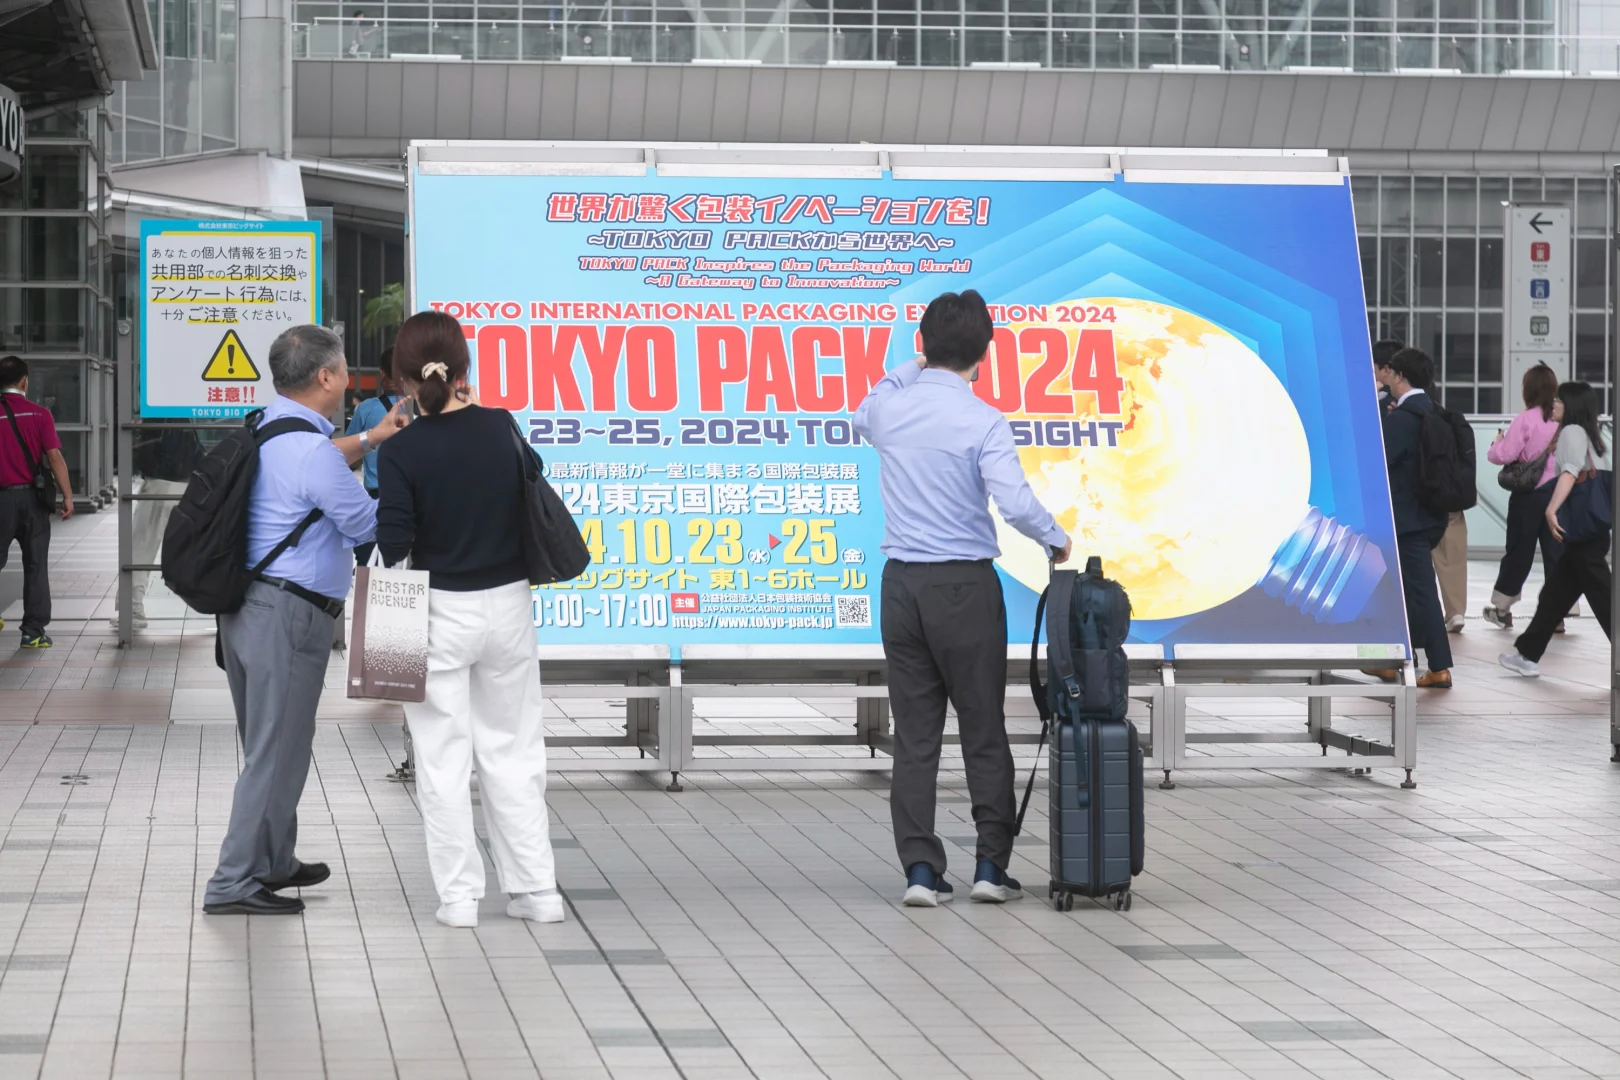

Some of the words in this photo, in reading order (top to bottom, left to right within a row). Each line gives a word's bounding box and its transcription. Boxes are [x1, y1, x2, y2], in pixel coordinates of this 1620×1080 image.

[548, 194, 991, 224] 世界が驚く包装イノベーションを!
[152, 247, 308, 260] あなたの個人情報を狙った
[151, 264, 308, 281] 共用部での名刺交換や
[579, 257, 637, 270] TOKYO
[641, 257, 689, 270] PACK
[694, 258, 775, 272] Inspires
[780, 258, 812, 271] the
[818, 258, 914, 274] Packaging
[919, 259, 971, 272] World
[676, 275, 755, 289] Gateway
[761, 277, 781, 288] to
[151, 285, 308, 303] アンケート行為には、
[161, 307, 292, 323] 十分ご注意ください。
[431, 302, 522, 319] TOKYO
[531, 302, 735, 319] INTERNATIONAL
[743, 303, 896, 321] PACKAGING
[1056, 306, 1117, 323] 2024
[463, 325, 678, 411] OKYO
[696, 326, 892, 412] PACK
[914, 328, 1124, 414] 024
[208, 387, 254, 403] 注意!!
[681, 419, 789, 444] 2024
[1008, 421, 1123, 446] SIGHT
[371, 579, 425, 595] AIRSTAR
[371, 594, 417, 609] AVENUE
[675, 598, 695, 608] 主催
[672, 615, 833, 629] https://www.tokyo-pack.jp
